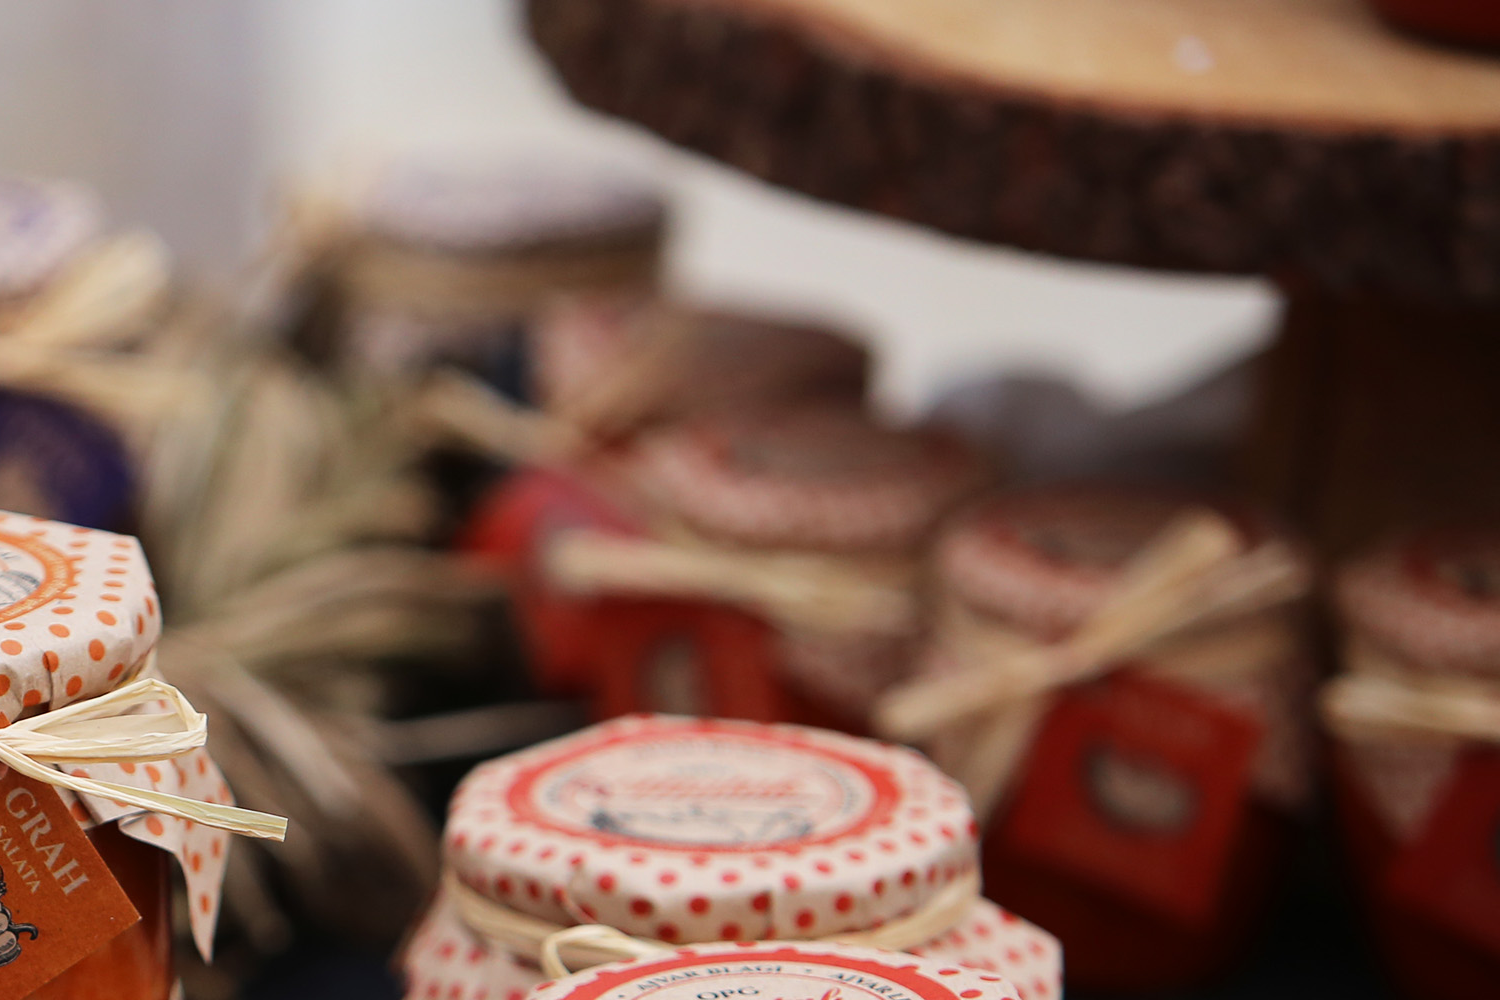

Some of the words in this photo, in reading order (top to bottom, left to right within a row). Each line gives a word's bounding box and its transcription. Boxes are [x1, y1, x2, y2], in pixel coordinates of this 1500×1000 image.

[5, 787, 90, 897] GRAH
[638, 969, 700, 991] AJVAR
[831, 973, 892, 993] AJVAR
[696, 986, 760, 1000] OPG
